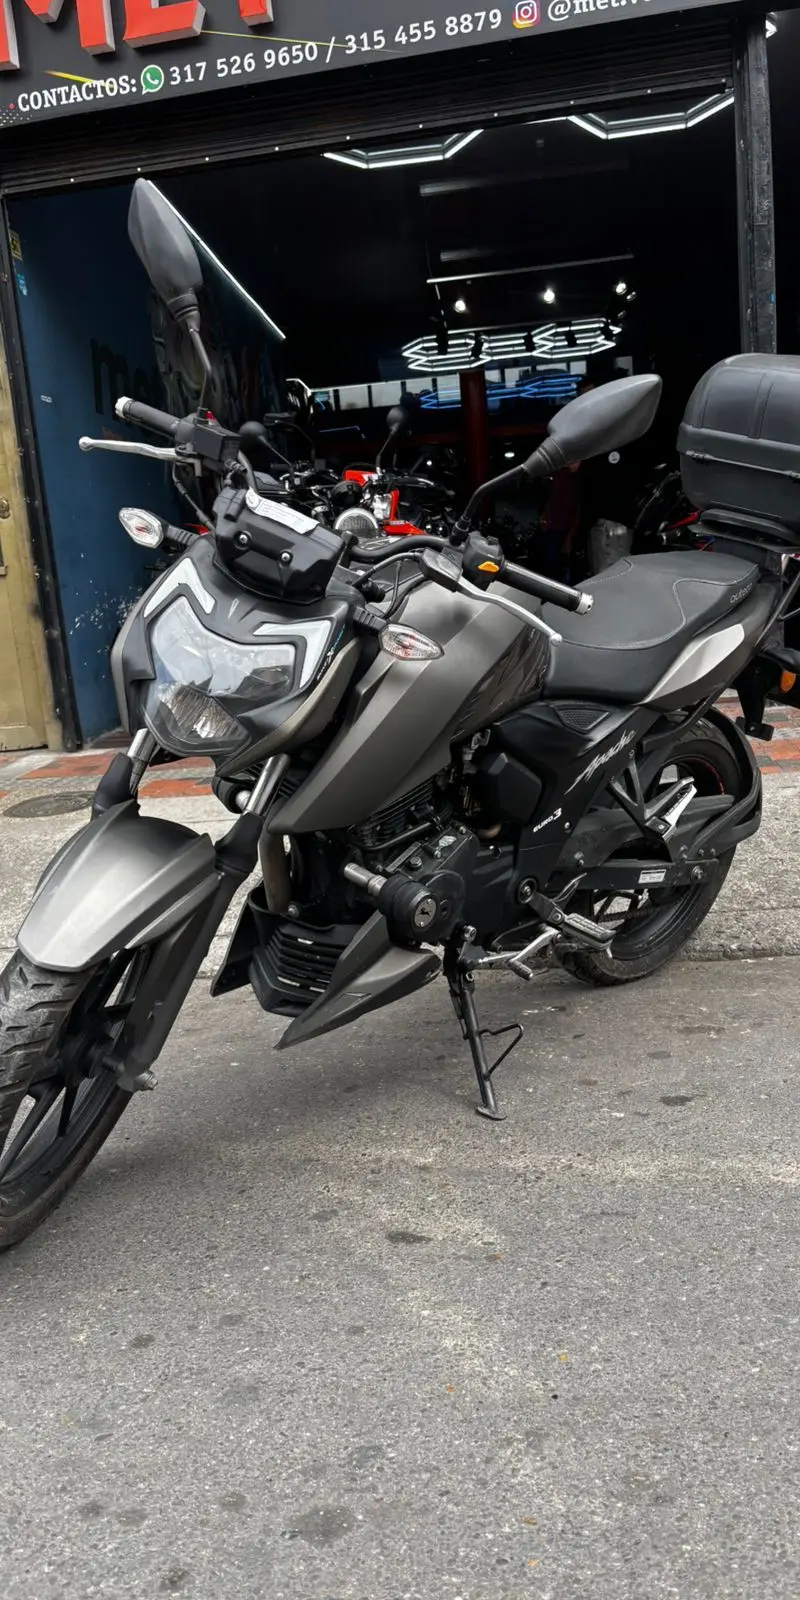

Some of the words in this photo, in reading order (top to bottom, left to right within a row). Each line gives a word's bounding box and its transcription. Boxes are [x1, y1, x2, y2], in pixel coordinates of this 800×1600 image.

[18, 75, 137, 112] CONTACTOS:
[169, 62, 207, 86] 317
[216, 53, 256, 78] 526
[263, 41, 319, 69] 9650
[325, 36, 336, 63] /
[344, 29, 386, 54] 315
[394, 20, 436, 45] 455
[445, 8, 502, 36] 8879
